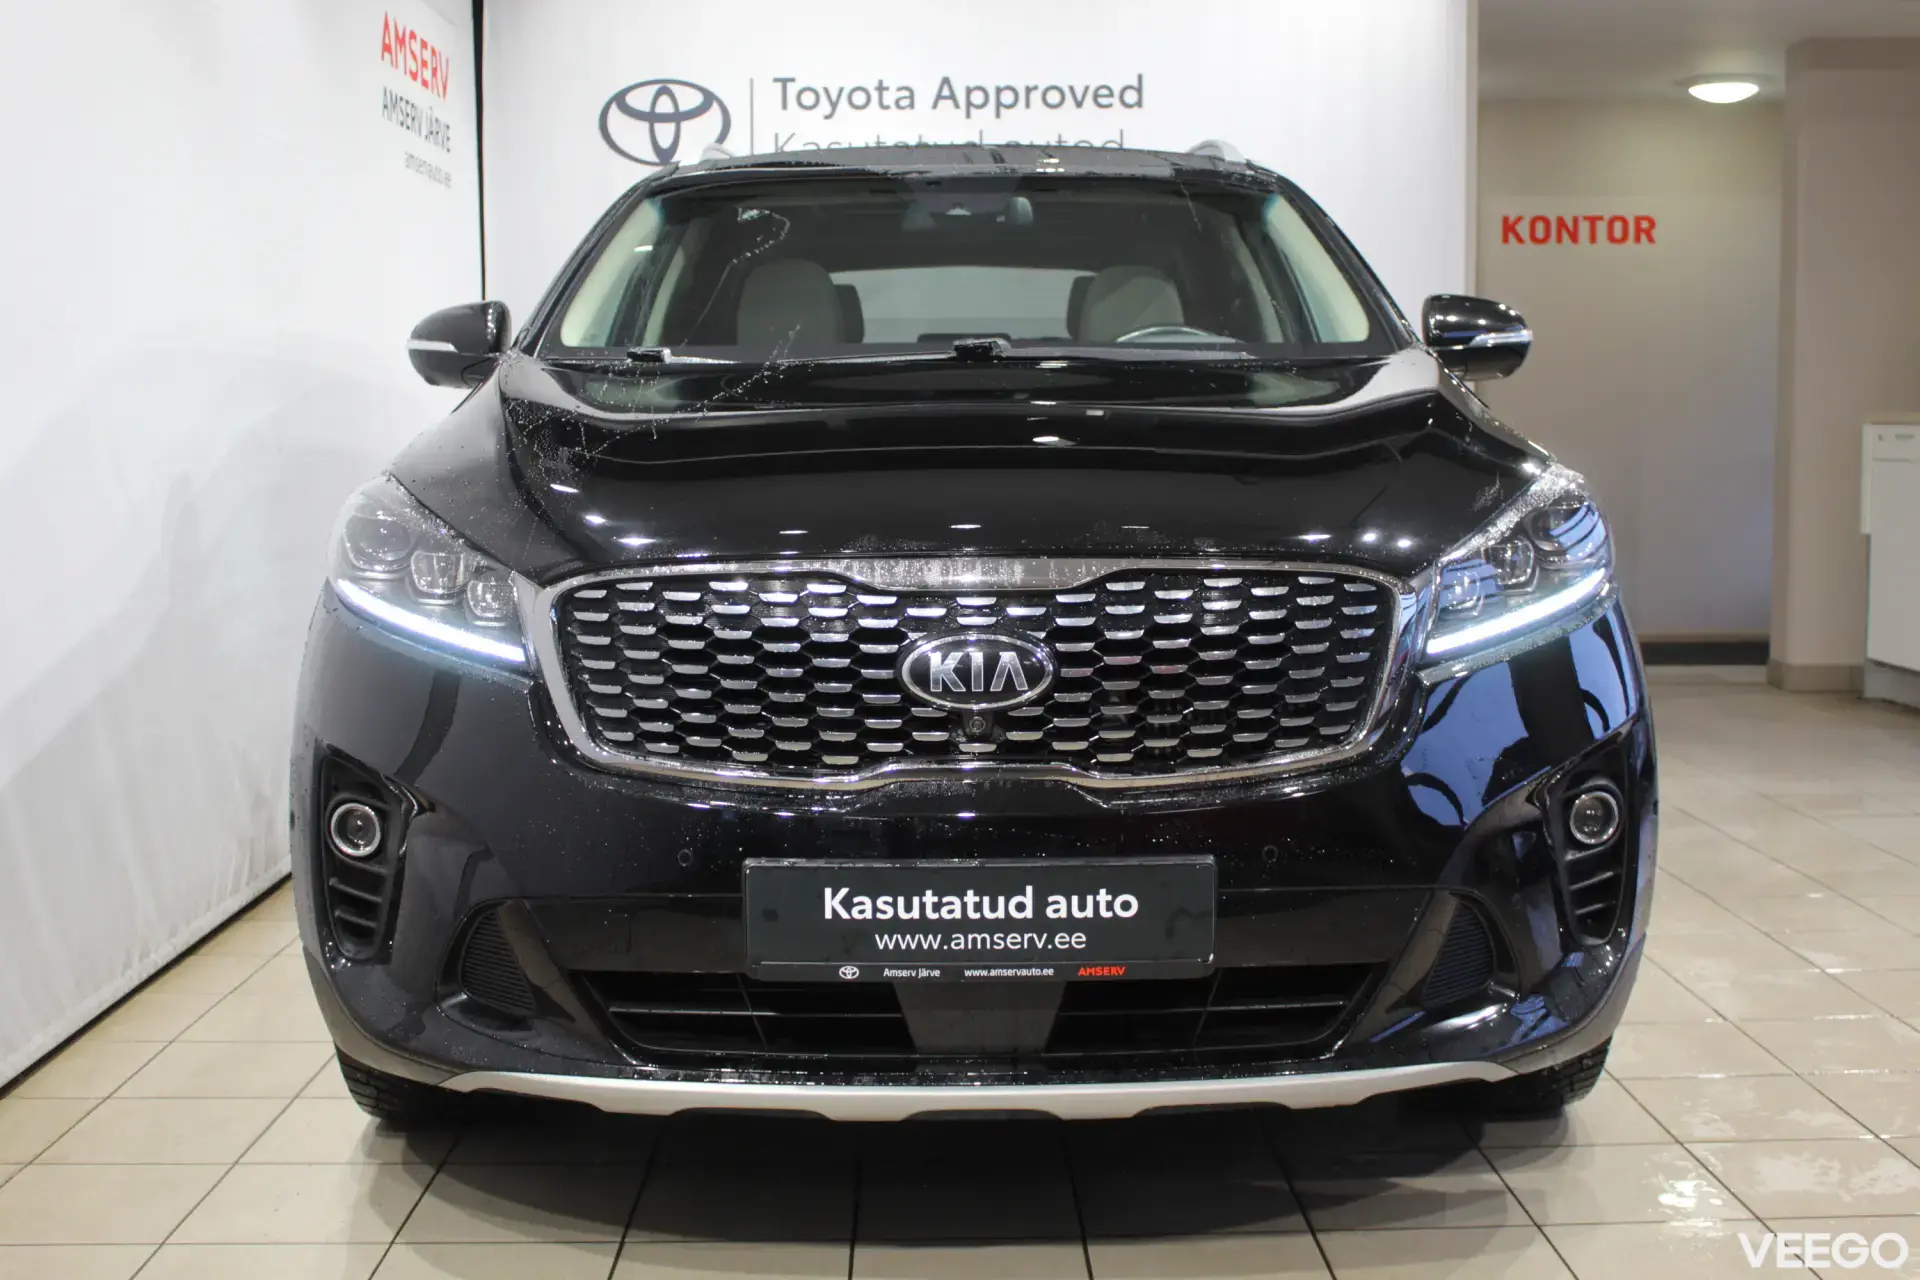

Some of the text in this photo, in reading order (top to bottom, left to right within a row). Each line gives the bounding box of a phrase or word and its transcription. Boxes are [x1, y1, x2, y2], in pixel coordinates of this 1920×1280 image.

[381, 10, 450, 101] AMSERV
[381, 85, 423, 137] AMSERV
[772, 73, 1144, 120] Toyota Approved
[1501, 214, 1656, 245] KONTOR
[928, 650, 1029, 693] KIA
[824, 885, 1139, 920] Kasutatud auto
[875, 931, 1087, 950] www.amserv.ee
[883, 966, 1127, 979] Amserv Järve www.amservauto.ee AMSERV
